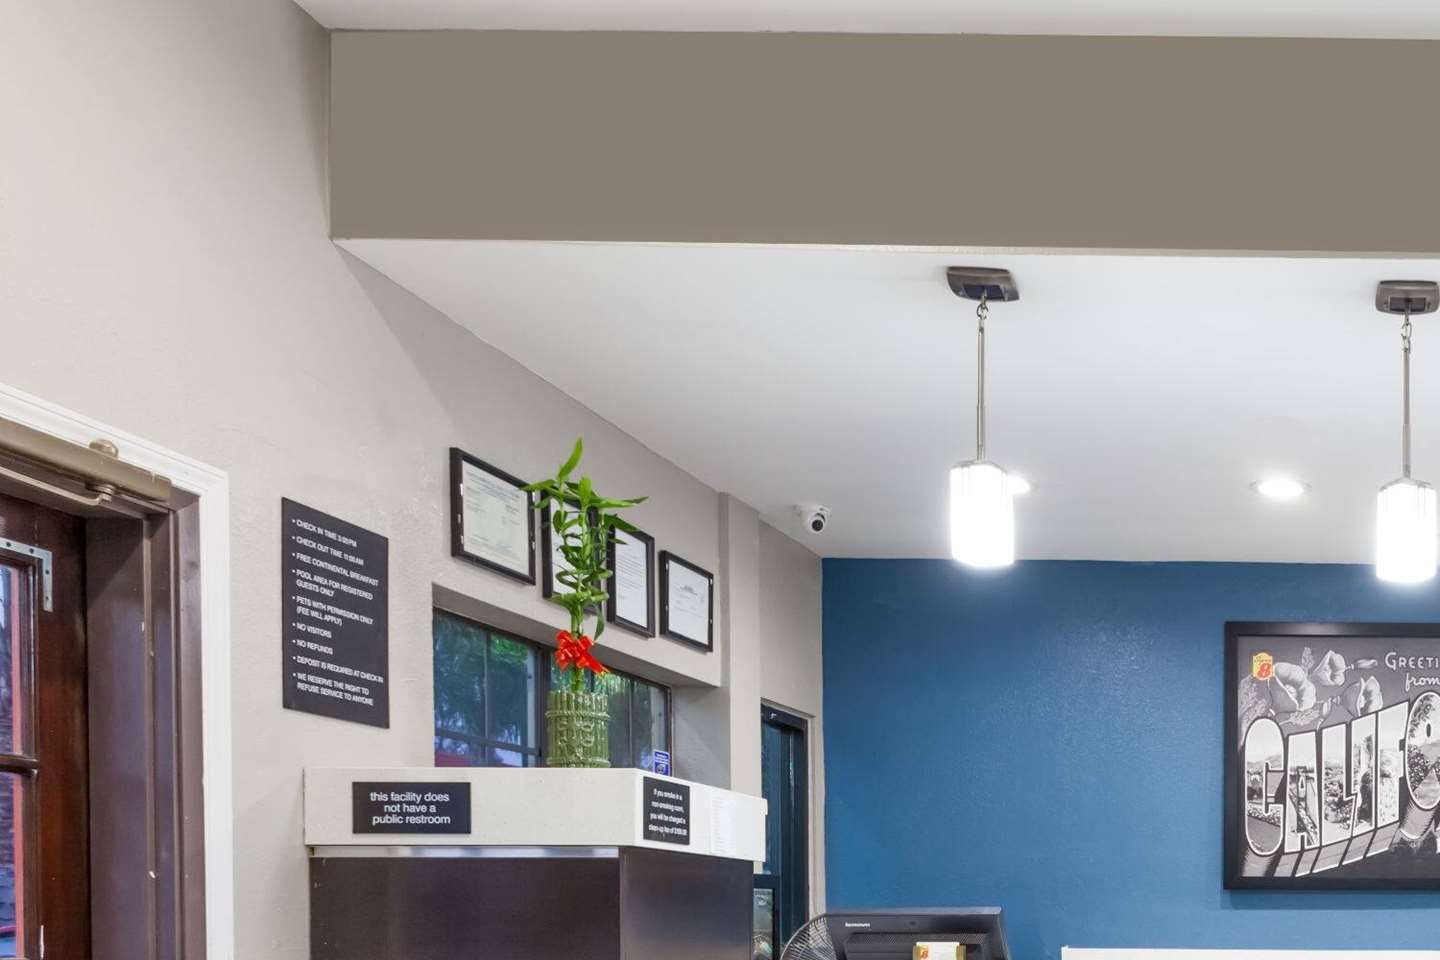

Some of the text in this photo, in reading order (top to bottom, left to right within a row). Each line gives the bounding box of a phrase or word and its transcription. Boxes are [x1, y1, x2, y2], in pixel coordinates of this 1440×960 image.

[296, 518, 336, 540] CHECK IN TIME
[296, 535, 342, 558] CHECK OUT TIME
[296, 552, 378, 586] FREE CONTINENTAL BREAKFAST
[296, 568, 373, 600] POOL AREA FOR REGISTERED
[296, 578, 334, 597] GUESTS ONLY
[296, 595, 373, 625] PETS WITH PERMISSION ONLY
[310, 609, 322, 620] WILL
[296, 622, 331, 638] NO VISITORS
[296, 638, 332, 655] NO REFUNDS
[296, 655, 359, 677] DEPOSIT IS REQUIRED AT
[297, 672, 369, 695] WE RESERVE THE RIGHT TO
[1405, 673, 1440, 691] from
[296, 681, 373, 705] REFUSE SERVICE TO ANYONE
[370, 792, 450, 803] this facility does
[384, 804, 401, 812] not
[403, 804, 427, 812] have
[372, 814, 451, 826] public restroom
